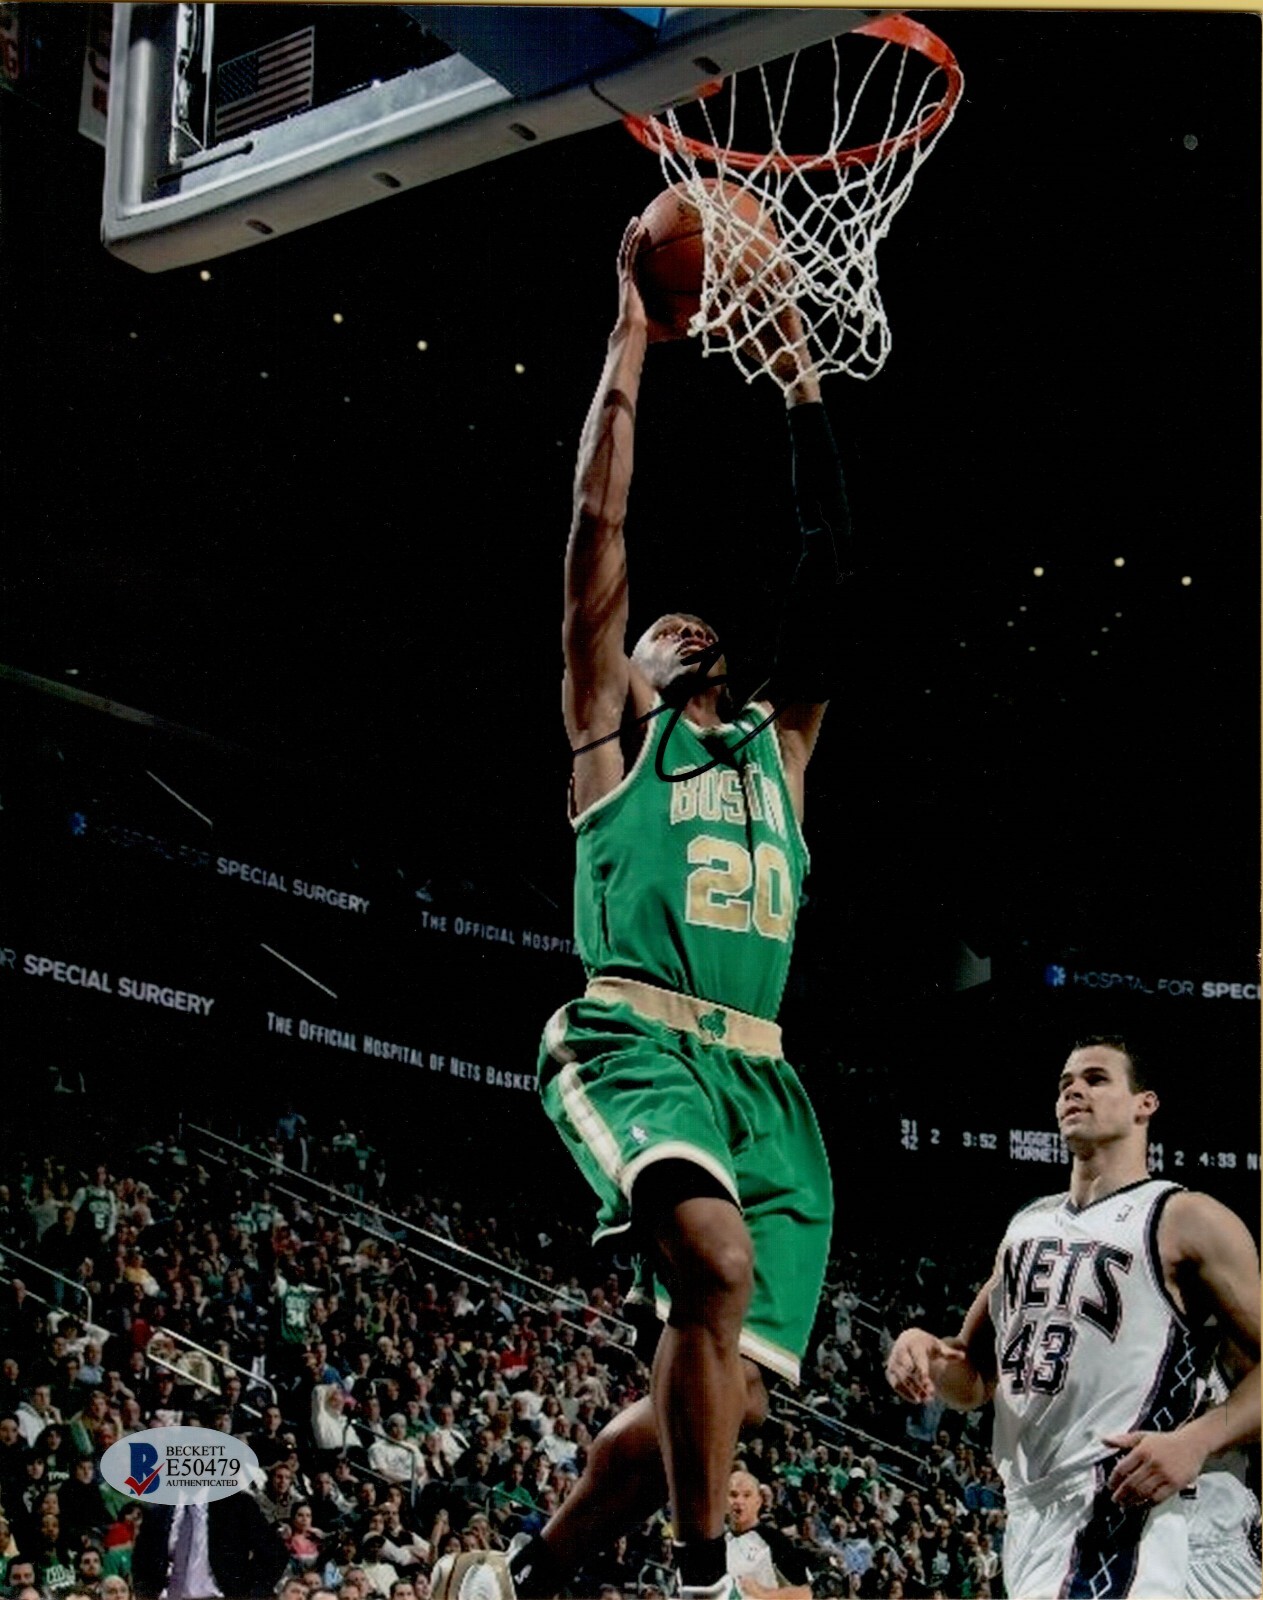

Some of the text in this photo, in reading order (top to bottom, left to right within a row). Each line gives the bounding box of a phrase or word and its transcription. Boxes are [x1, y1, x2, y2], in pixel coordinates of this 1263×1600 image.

[670, 763, 788, 840] BOST
[215, 856, 288, 893] SPECIAL
[291, 879, 370, 915] SURGERY
[685, 834, 796, 943] 20
[420, 910, 447, 933] THE
[454, 915, 516, 946] OFFICIAL
[23, 953, 113, 994] SPECIAL
[117, 976, 216, 1017] SURGERY
[1157, 977, 1195, 996] FOR
[266, 1010, 294, 1036] THE
[299, 1018, 358, 1052] OFFICIAL
[362, 1034, 424, 1069] HOSPITAL
[429, 1053, 447, 1073] OF
[450, 1057, 481, 1082] NETS
[900, 1135, 919, 1151] 42
[930, 1128, 941, 1145] 2
[1009, 1129, 1068, 1149] NUGGET
[1009, 1147, 1070, 1165] HORNETS
[1174, 1150, 1185, 1167] 2
[1002, 1238, 1133, 1343] NETS
[1001, 1321, 1076, 1395] 43
